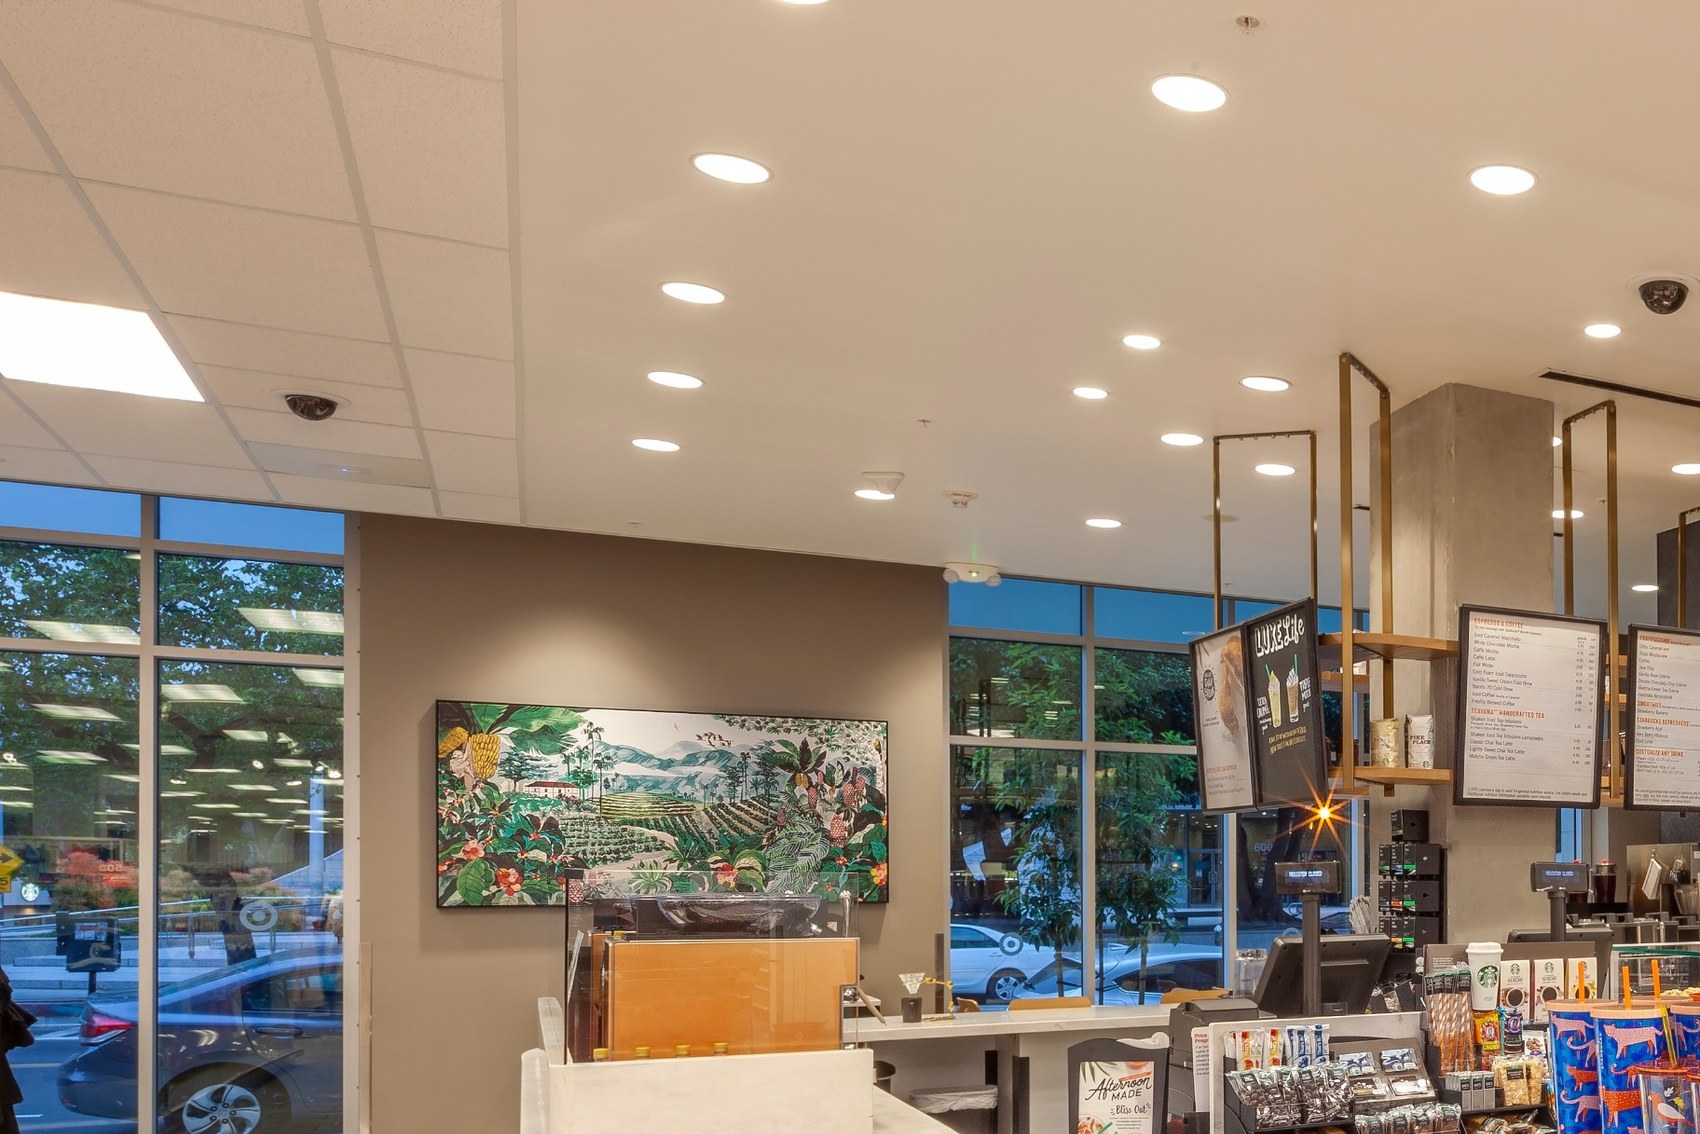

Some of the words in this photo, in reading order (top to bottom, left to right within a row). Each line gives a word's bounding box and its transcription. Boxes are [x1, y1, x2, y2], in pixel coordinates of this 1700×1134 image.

[1474, 618, 1499, 626] ESPRESSO
[1255, 620, 1284, 657] LUXE
[1283, 614, 1304, 646] Life
[1500, 710, 1534, 718] HANDCRAFTED
[1085, 1077, 1152, 1100] Afternoon
[1112, 1088, 1141, 1101] MADE
[1116, 1105, 1131, 1114] Bliss
[1134, 1105, 1147, 1114] Out
